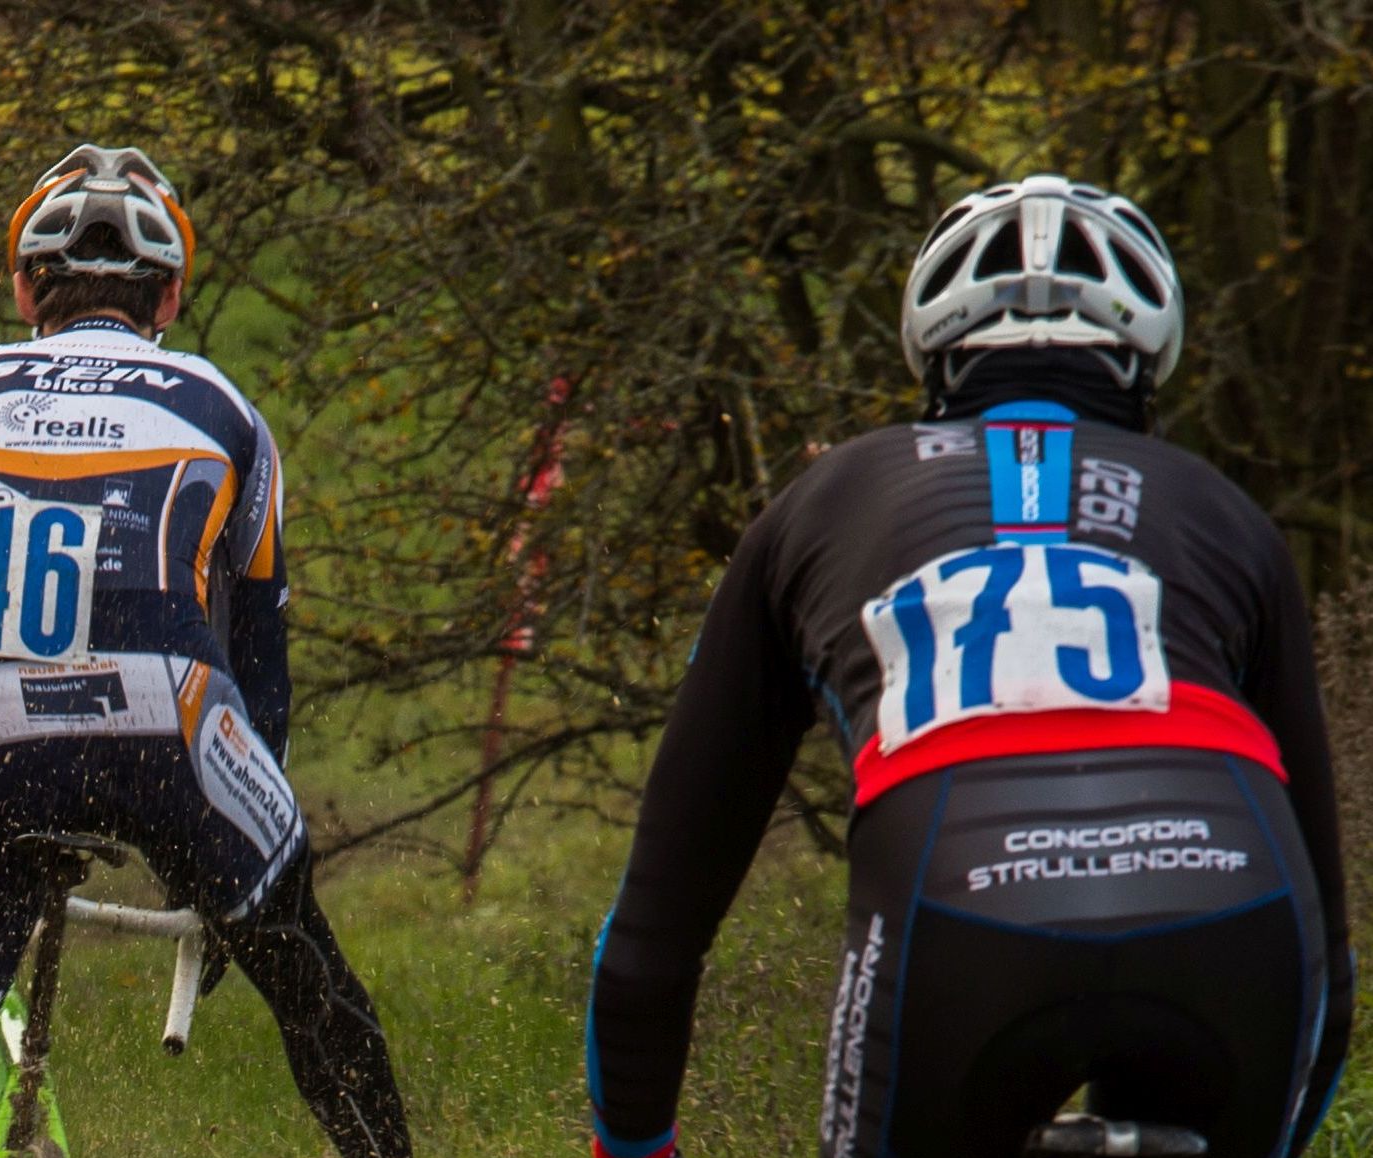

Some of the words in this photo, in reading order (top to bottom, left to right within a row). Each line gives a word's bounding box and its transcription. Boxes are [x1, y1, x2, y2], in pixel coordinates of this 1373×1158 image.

[52, 354, 118, 368] Team
[33, 375, 115, 393] bikes
[32, 417, 126, 440] realis
[1076, 457, 1144, 541] 1920
[873, 543, 1145, 734] 175
[1004, 819, 1211, 852] CONCORDIA
[967, 847, 1249, 892] STRULLENDORF
